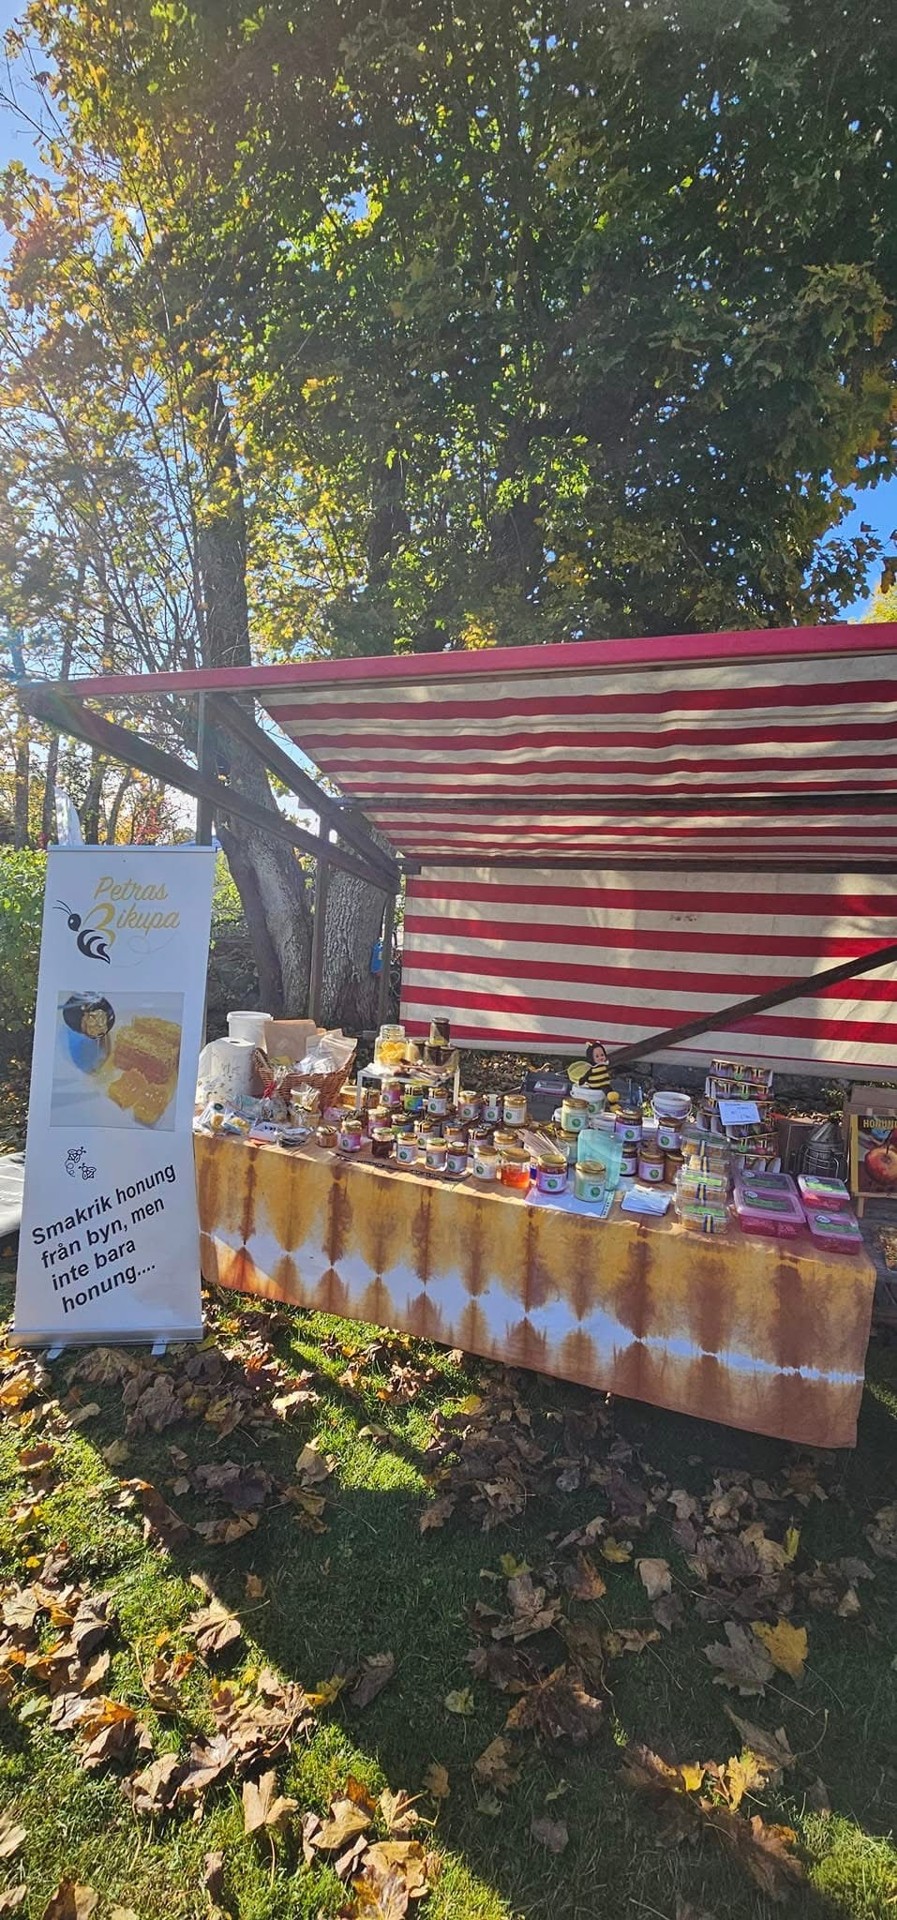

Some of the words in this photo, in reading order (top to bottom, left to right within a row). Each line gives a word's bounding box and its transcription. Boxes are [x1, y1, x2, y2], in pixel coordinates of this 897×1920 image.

[94, 876, 168, 901] Petras
[32, 1196, 113, 1245] Smakrik
[115, 1164, 177, 1205] honung
[40, 1238, 81, 1268] från
[86, 1218, 128, 1246] byn,
[131, 1198, 165, 1225] men
[51, 1263, 90, 1291] inte
[94, 1239, 136, 1270] bara
[61, 1264, 156, 1313] honung....
